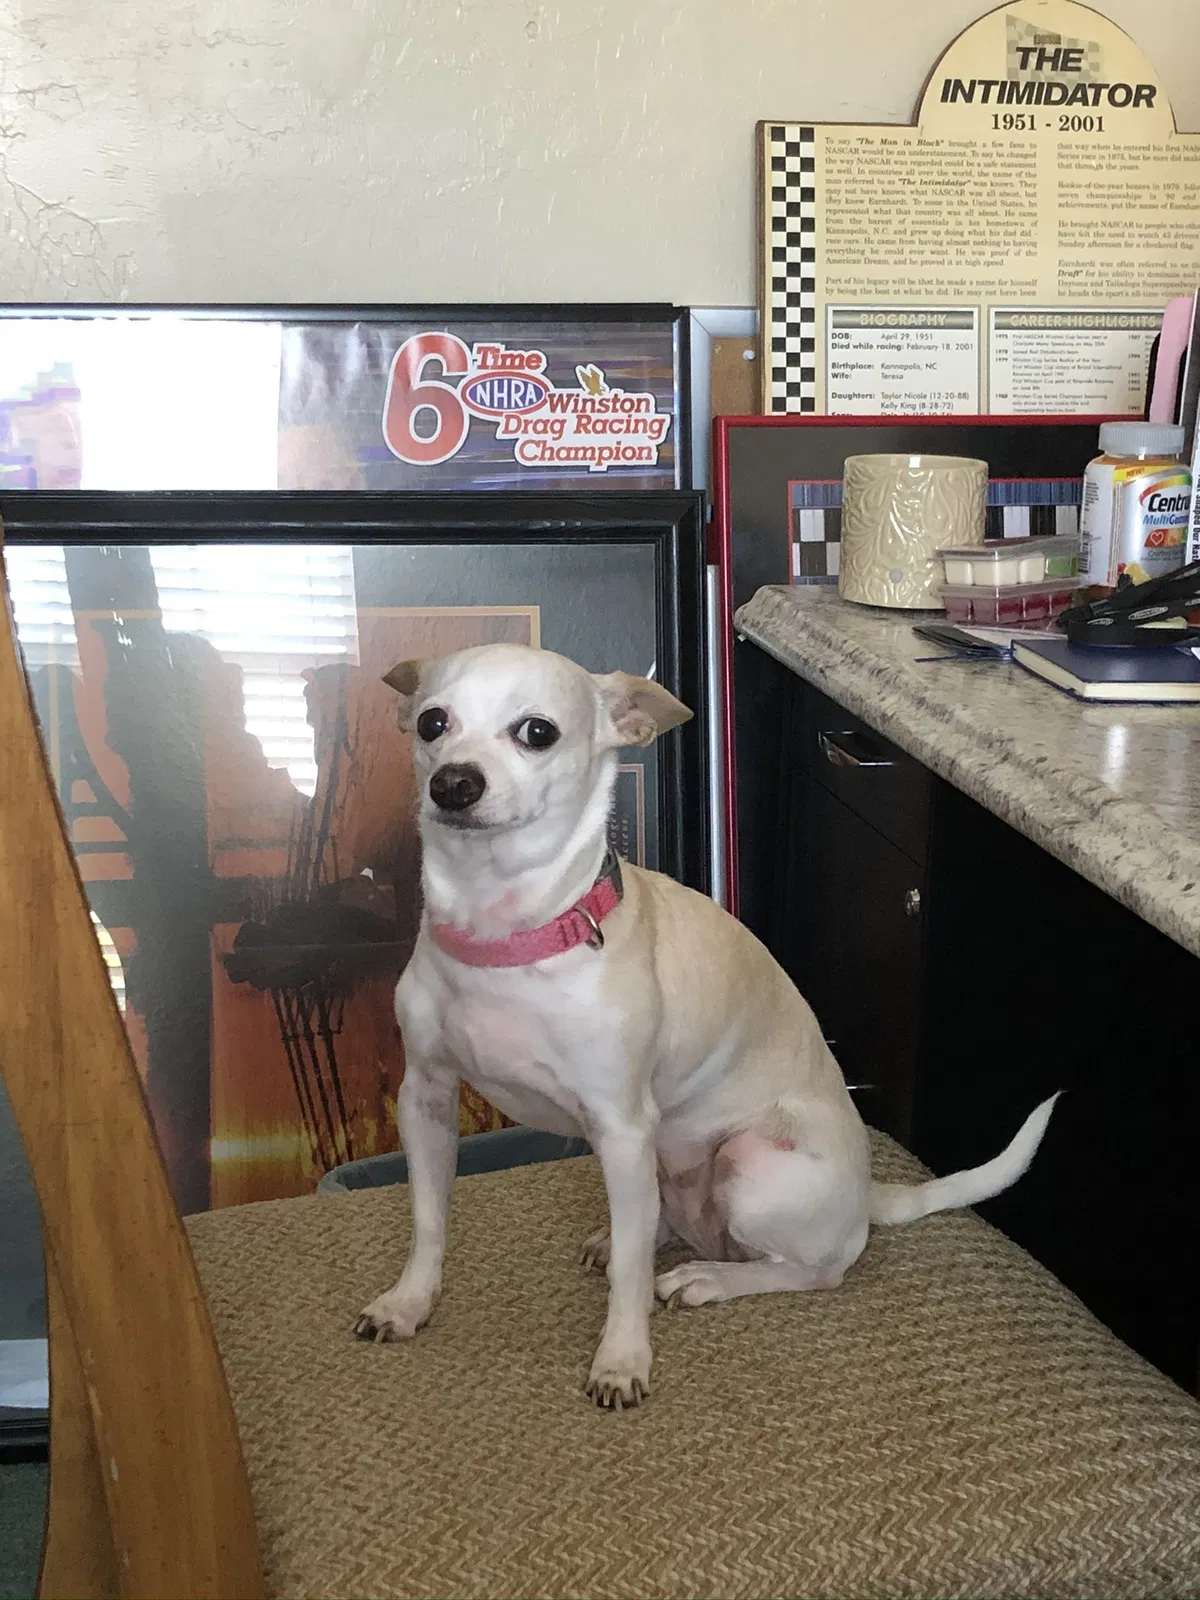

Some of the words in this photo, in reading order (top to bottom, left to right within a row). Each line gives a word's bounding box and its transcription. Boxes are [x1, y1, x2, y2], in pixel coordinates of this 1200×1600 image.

[1016, 47, 1084, 72] THE
[941, 79, 1156, 108] INTIMIDATOR
[992, 114, 1037, 130] 1951
[1059, 115, 1104, 132] 2001
[948, 140, 977, 149] brought
[910, 159, 942, 168] regarded
[1006, 150, 1036, 160] changed
[1018, 180, 1036, 189] They
[825, 207, 869, 217] represented
[914, 208, 942, 218] country
[860, 314, 946, 326] BIOGRAPHY
[1011, 315, 1062, 326] CAREER
[1067, 315, 1156, 327] HIGHLIGHTS
[476, 346, 541, 369] Time
[385, 334, 468, 463] 6
[477, 380, 536, 406] NHRA
[546, 393, 650, 413] Winston
[502, 415, 566, 440] Drag
[573, 414, 664, 440] Racing
[519, 440, 652, 464] Champion
[1126, 468, 1144, 478] NEW!
